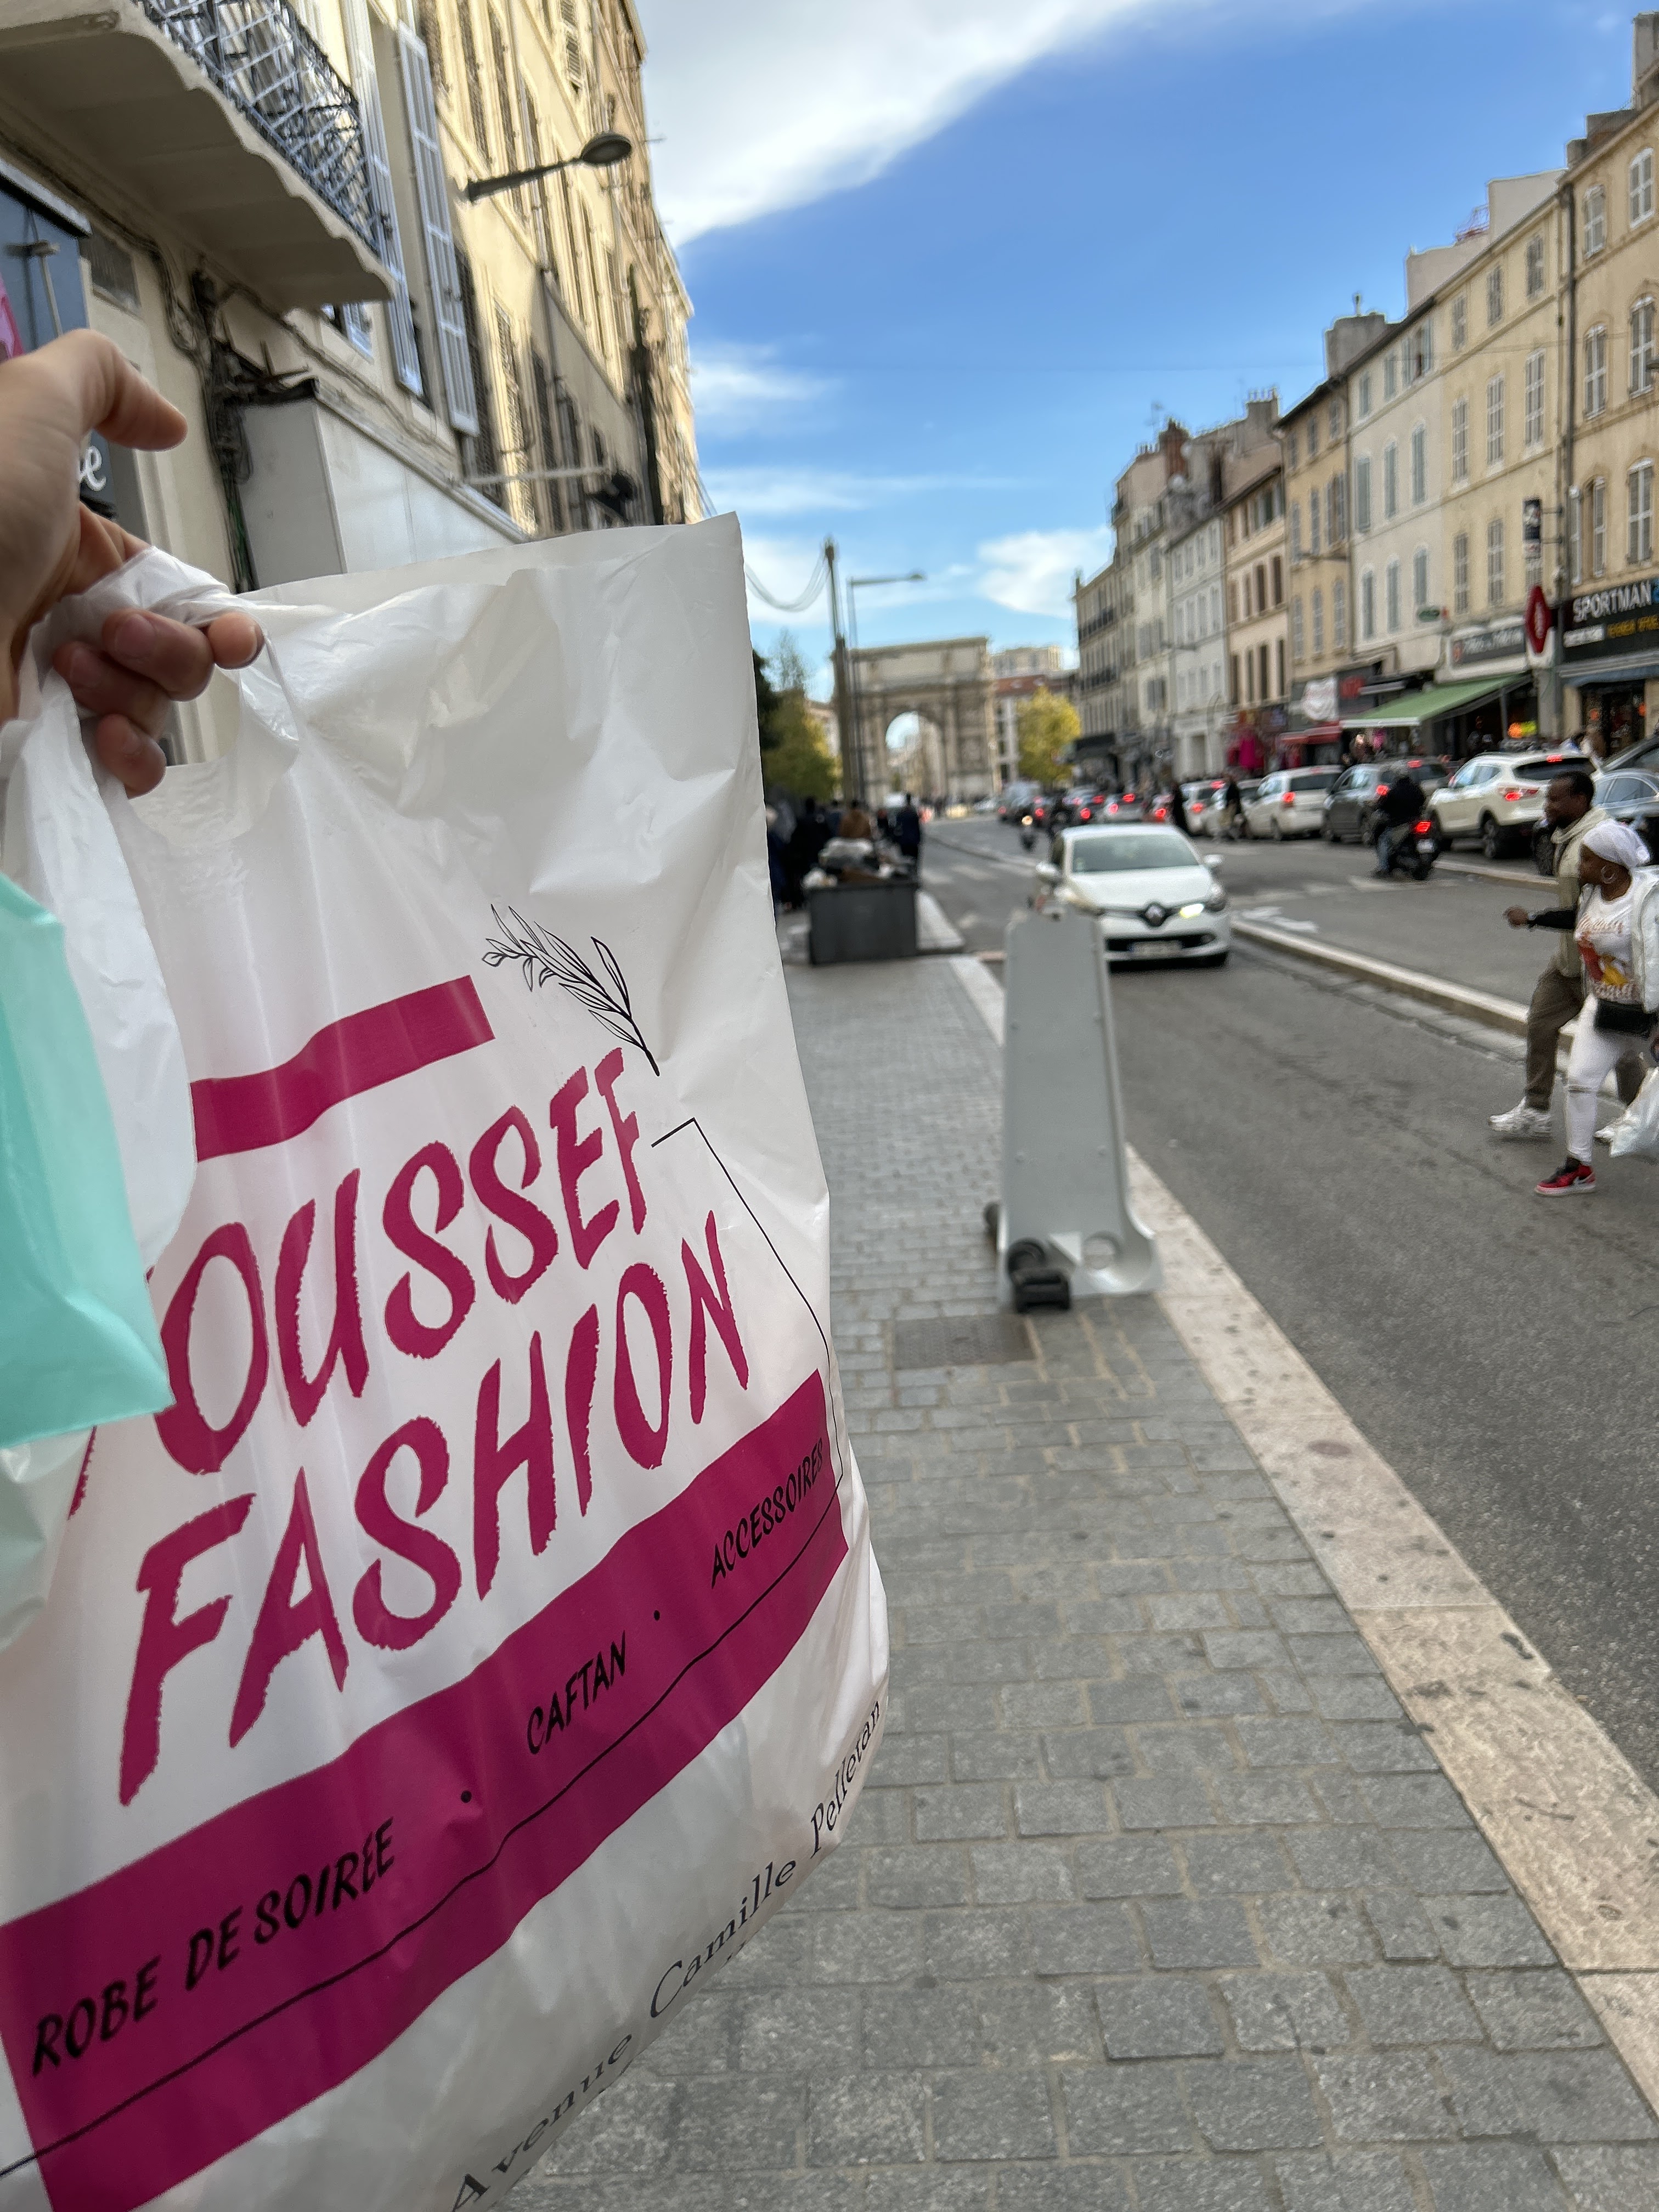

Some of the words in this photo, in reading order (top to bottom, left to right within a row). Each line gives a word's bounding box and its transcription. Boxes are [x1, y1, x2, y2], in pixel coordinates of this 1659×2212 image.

[1573, 579, 1652, 623] SPORTMAN
[68, 1047, 646, 1521] OUSSEF
[119, 1210, 749, 1807] FASHION
[31, 1956, 161, 2077] ROBE
[185, 1906, 243, 1991] DE
[527, 1630, 626, 1755] CAFTAN
[712, 1437, 823, 1589] ACCESSOIRES
[452, 2034, 632, 2212] Avenue
[651, 1860, 797, 2018] Camille
[810, 1700, 880, 1859] Pelletan
